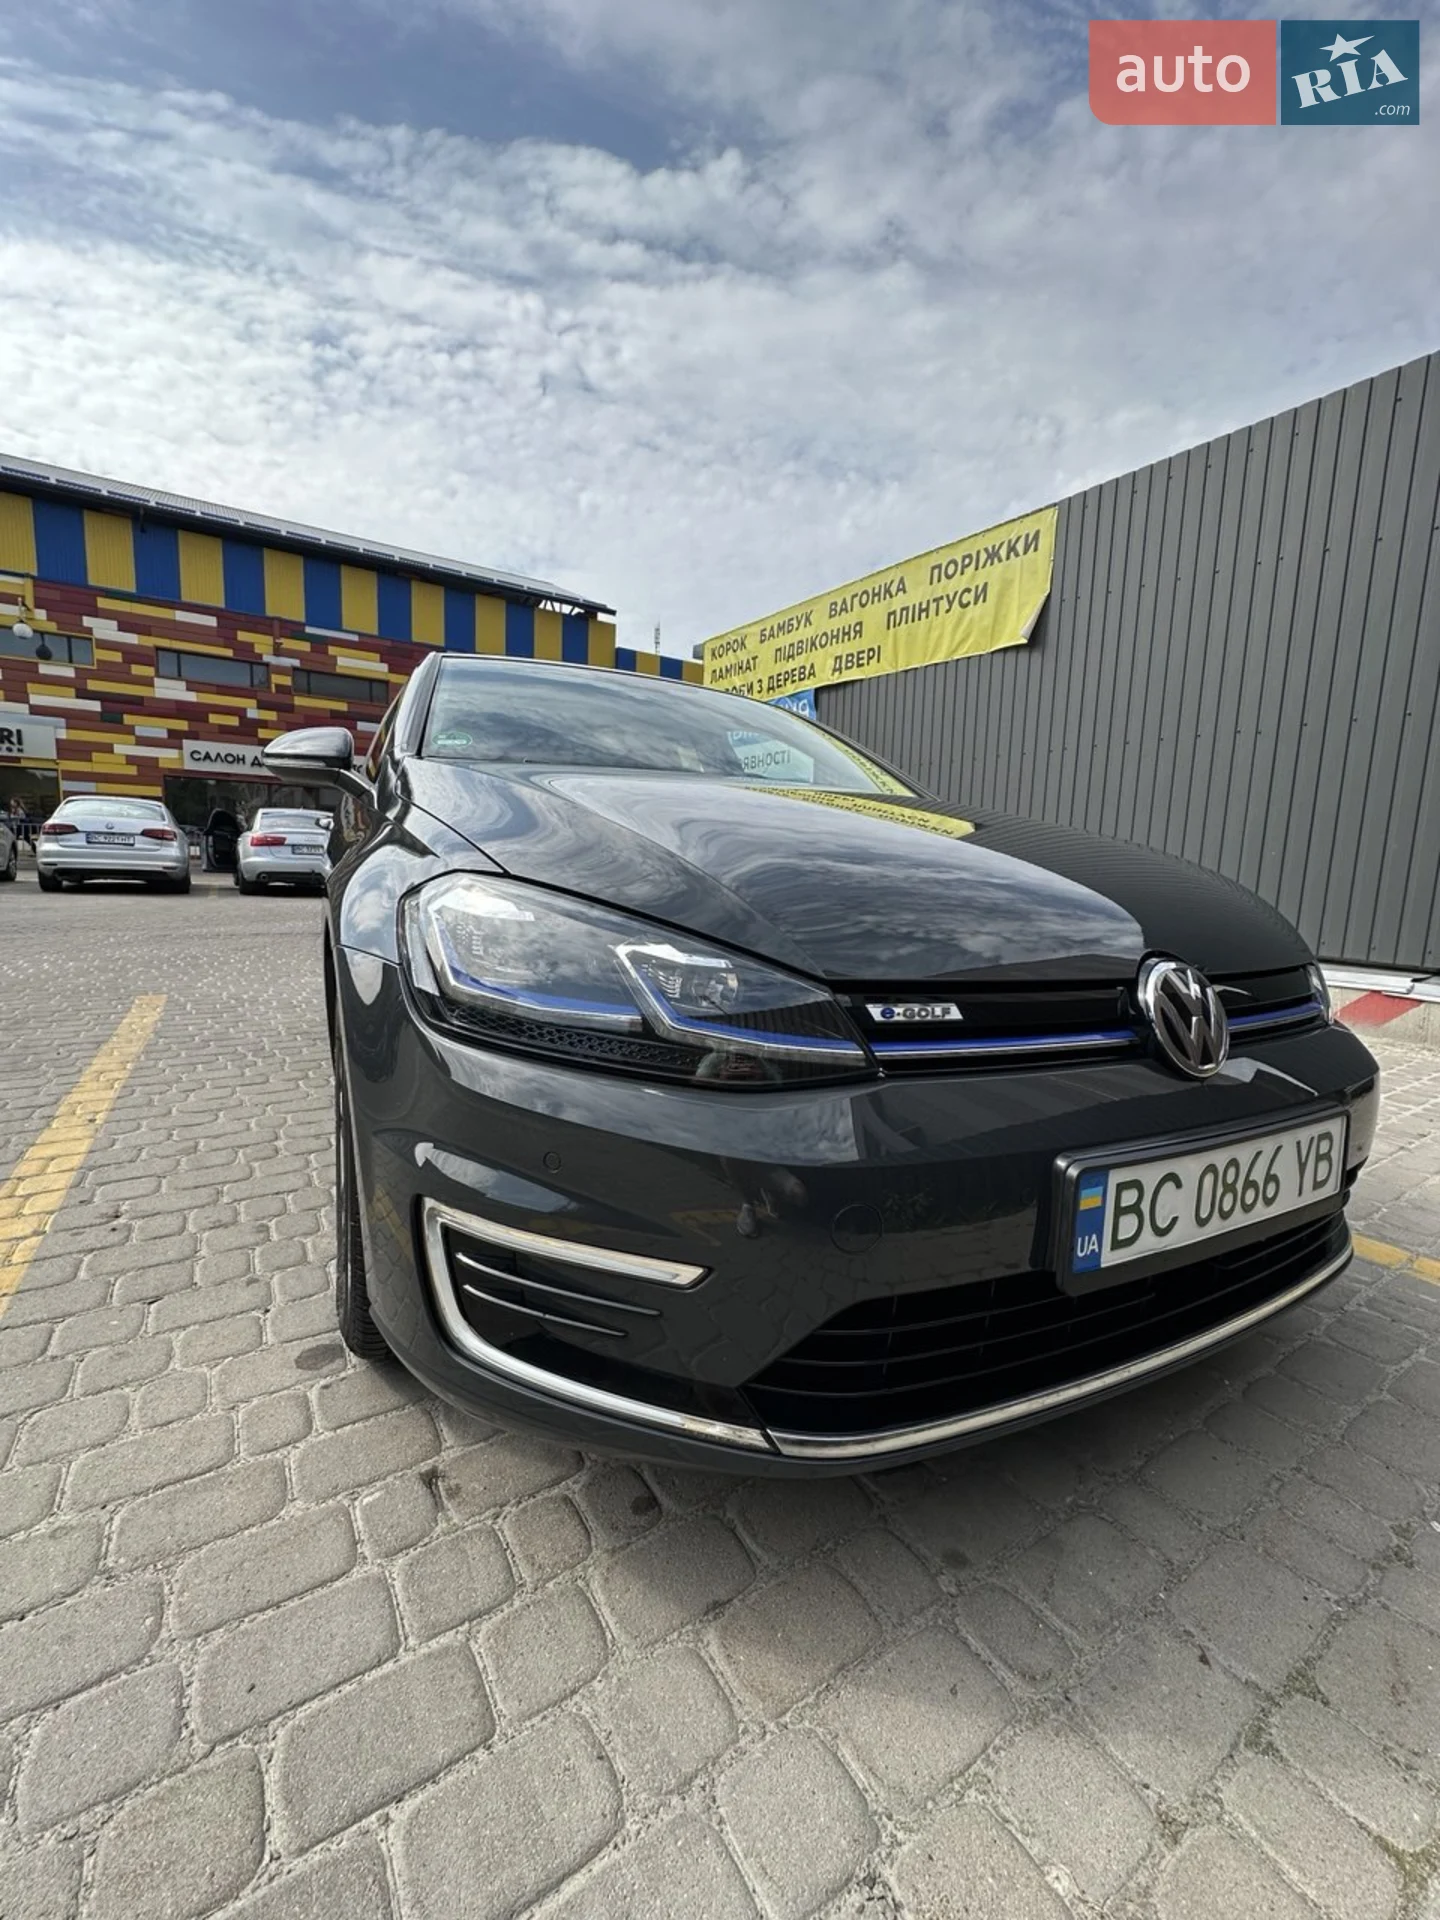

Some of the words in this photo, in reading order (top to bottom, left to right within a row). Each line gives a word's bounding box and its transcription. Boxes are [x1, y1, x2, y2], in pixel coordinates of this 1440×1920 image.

[711, 635, 747, 661] КОРОК
[760, 610, 813, 644] БАМБУК
[829, 576, 907, 619] ВАГОНКА
[929, 529, 1040, 585] ПОРІЖКИ
[710, 656, 758, 684] ЛАМІНАТ
[774, 621, 863, 664] ПІДВІКОННЯ
[887, 582, 988, 630] ПЛІНТУСИ
[767, 663, 816, 694] ДЕРЕВА
[831, 645, 882, 676] ДВЕРІ
[190, 749, 246, 765] САЛОН
[1110, 1172, 1183, 1251] BC
[1194, 1145, 1283, 1228] 0866
[1296, 1131, 1334, 1197] YB
[1076, 1233, 1099, 1258] UA
